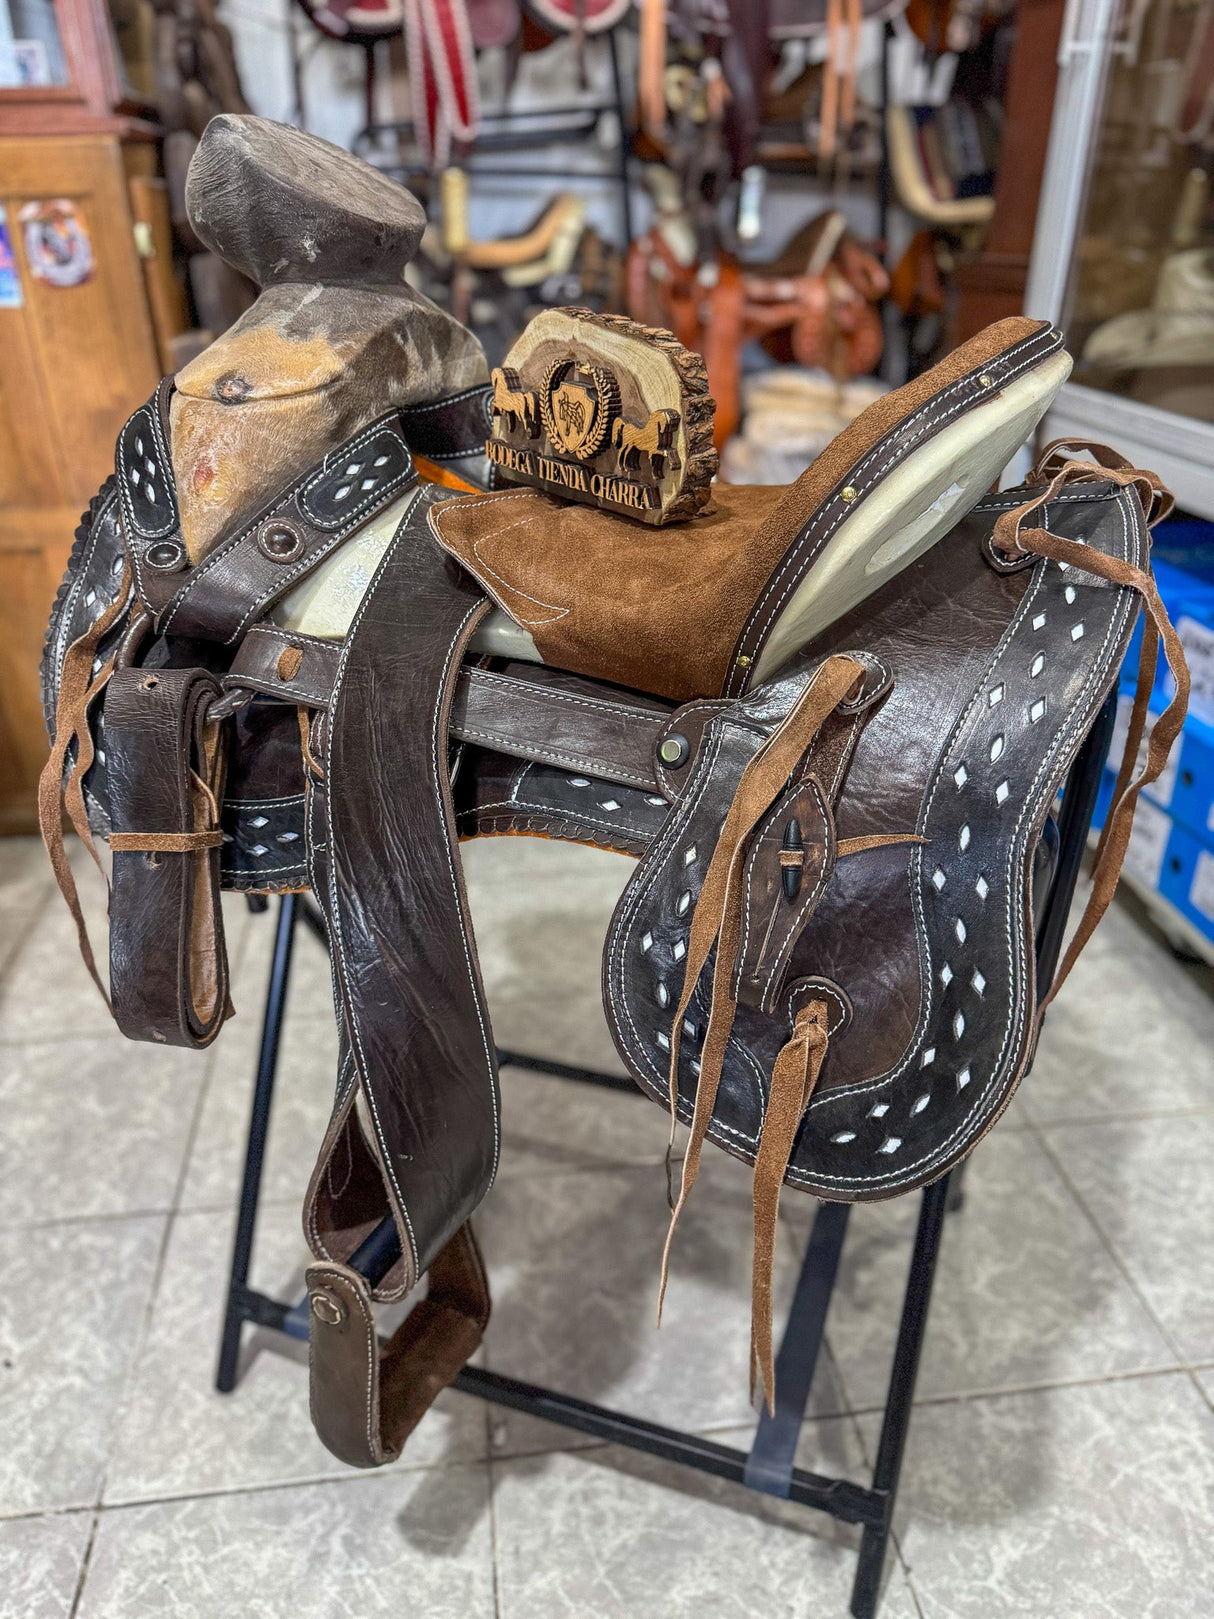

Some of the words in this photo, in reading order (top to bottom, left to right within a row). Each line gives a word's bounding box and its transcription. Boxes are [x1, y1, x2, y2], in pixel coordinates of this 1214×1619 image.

[485, 440, 533, 476] BODEGA
[537, 456, 588, 493] TIENDA
[590, 474, 652, 510] CHARRA
